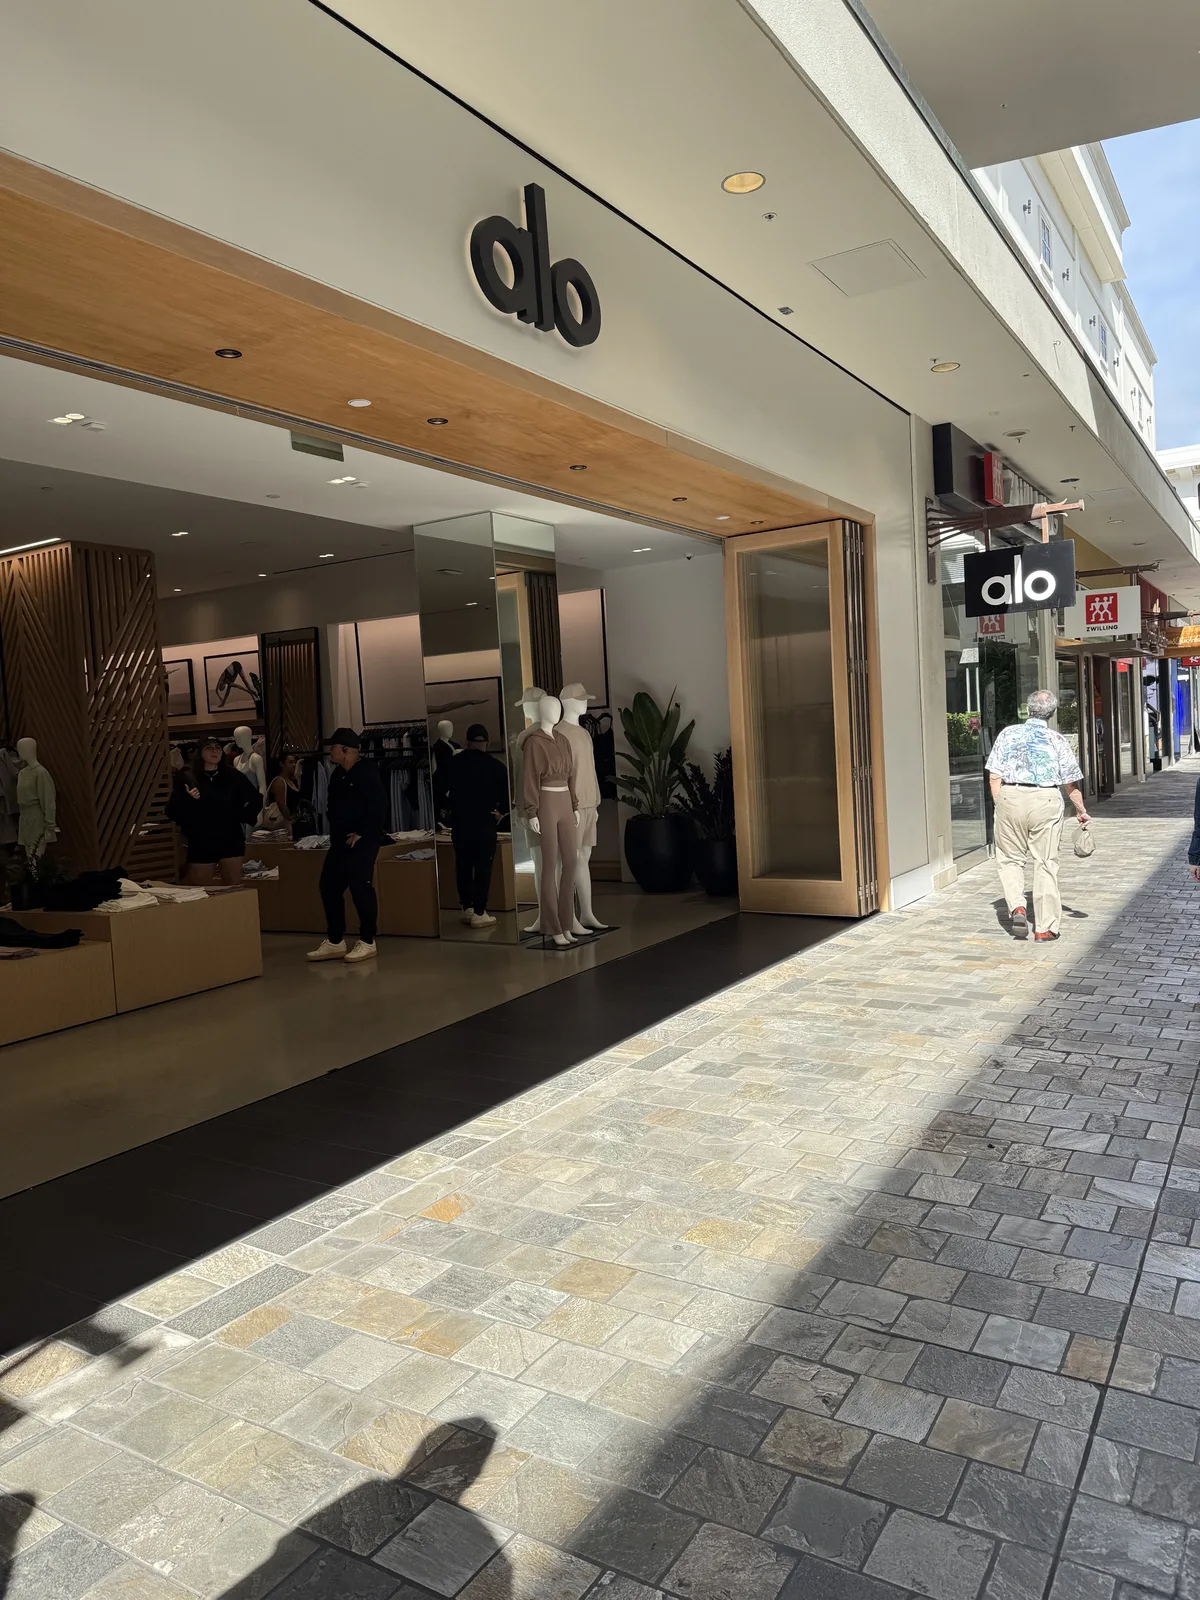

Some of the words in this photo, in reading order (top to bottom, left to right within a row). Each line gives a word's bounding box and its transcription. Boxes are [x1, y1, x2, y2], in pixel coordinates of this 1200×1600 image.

[470, 182, 602, 348] alo
[981, 554, 1057, 606] alo
[1086, 624, 1119, 632] ZWILLING
